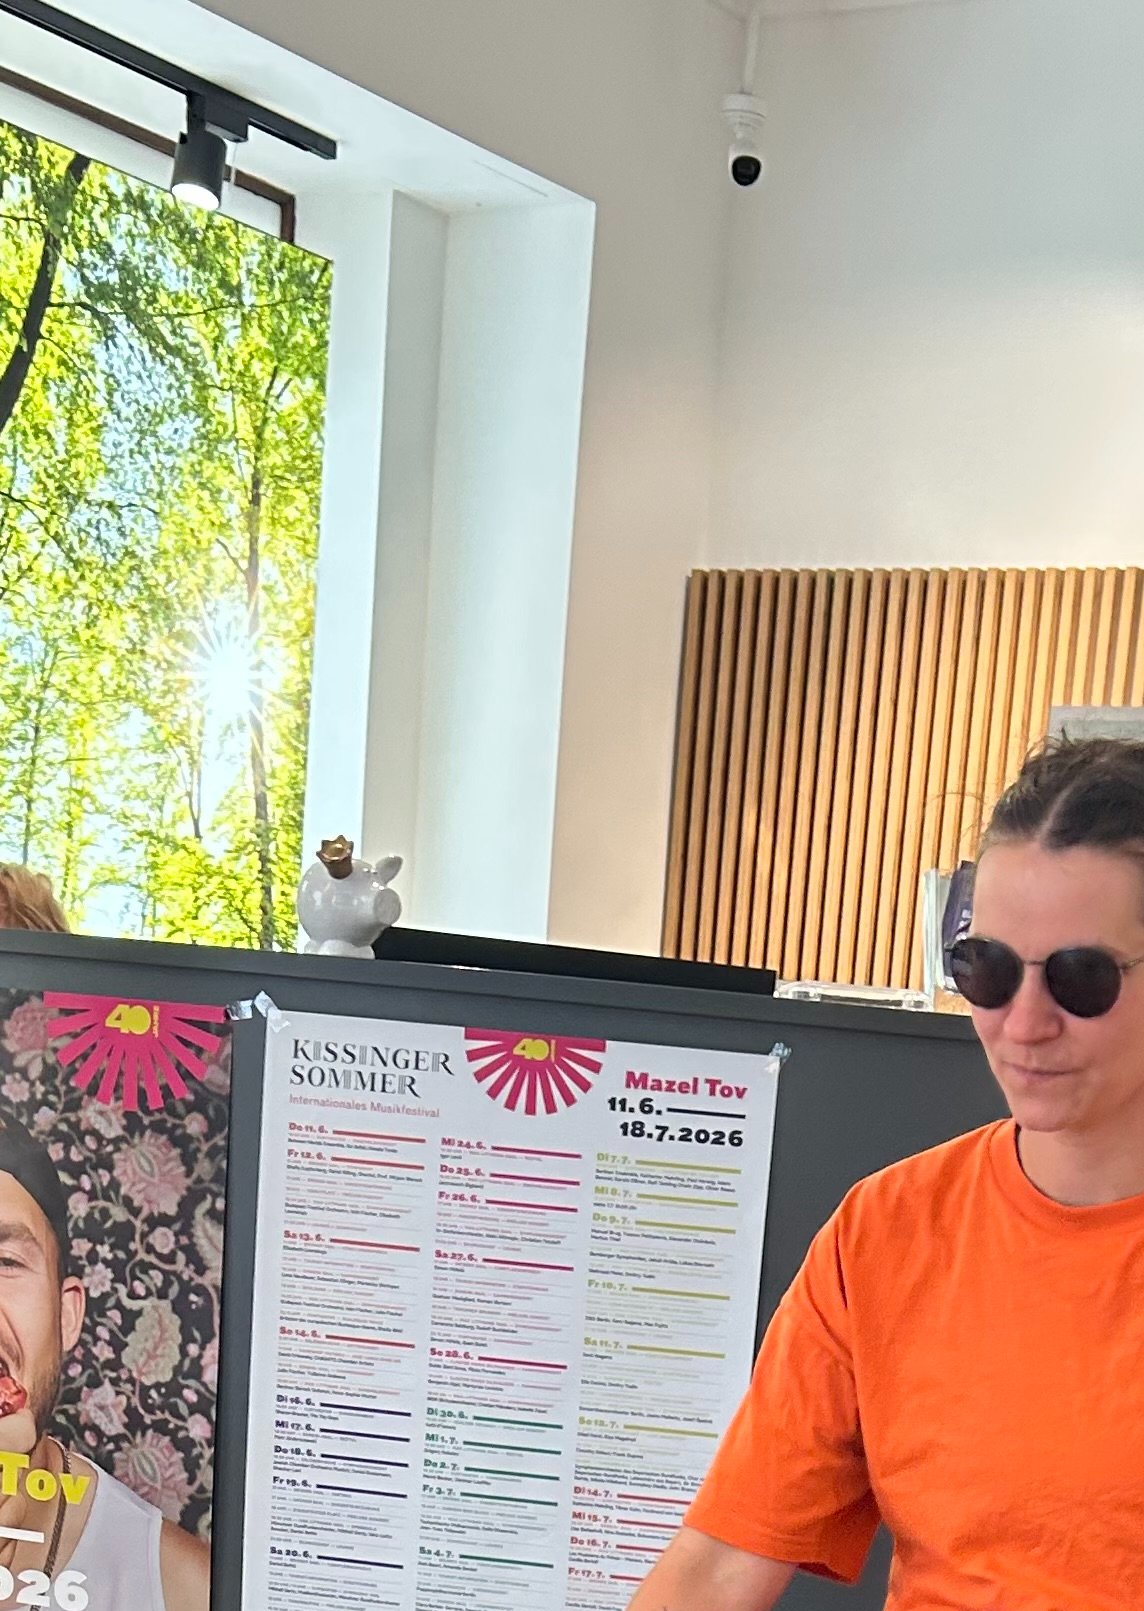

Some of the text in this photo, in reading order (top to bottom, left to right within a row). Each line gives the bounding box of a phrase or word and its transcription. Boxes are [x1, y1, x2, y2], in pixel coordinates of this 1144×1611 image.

[292, 1038, 455, 1076] KISSINGER
[289, 1064, 422, 1099] SOMMER
[624, 1071, 748, 1100] Mazel Tov
[289, 1094, 440, 1119] Internationales Musikfestival
[620, 1121, 744, 1147] 18.7.2026
